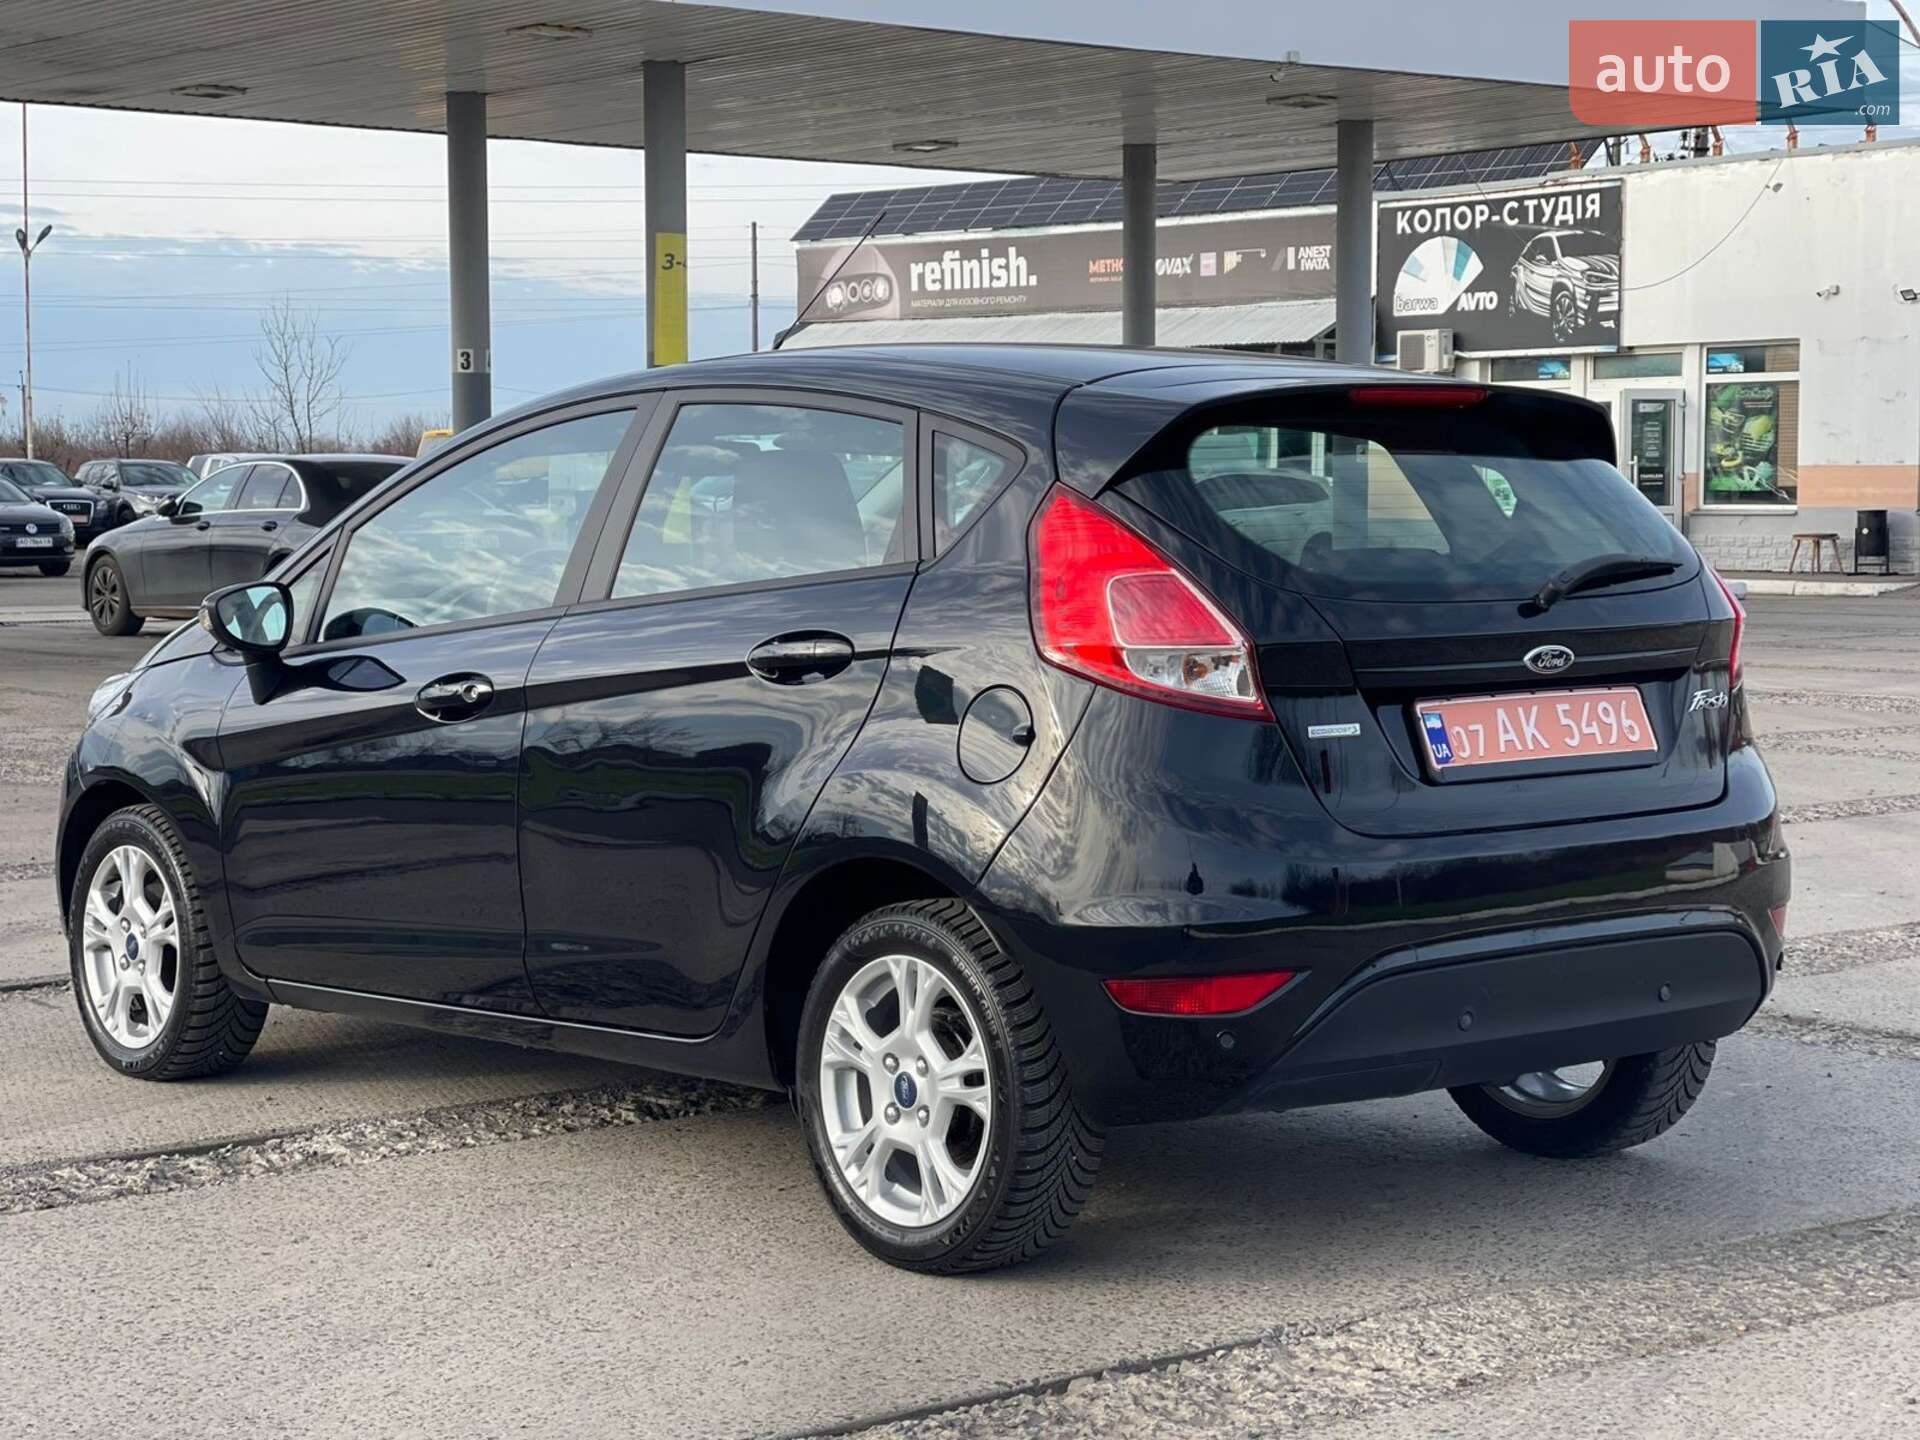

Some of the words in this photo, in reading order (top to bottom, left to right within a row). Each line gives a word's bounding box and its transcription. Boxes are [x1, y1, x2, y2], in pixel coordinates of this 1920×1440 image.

[1396, 192, 1601, 234] КОЛОР-СТУДІЯ
[1298, 245, 1332, 259] ANEST
[910, 246, 1037, 292] refinish.
[1396, 296, 1439, 313] barwa
[460, 351, 470, 370] 3
[1537, 651, 1567, 668] Ford
[1556, 700, 1641, 749] 5496
[1432, 743, 1452, 760] UA
